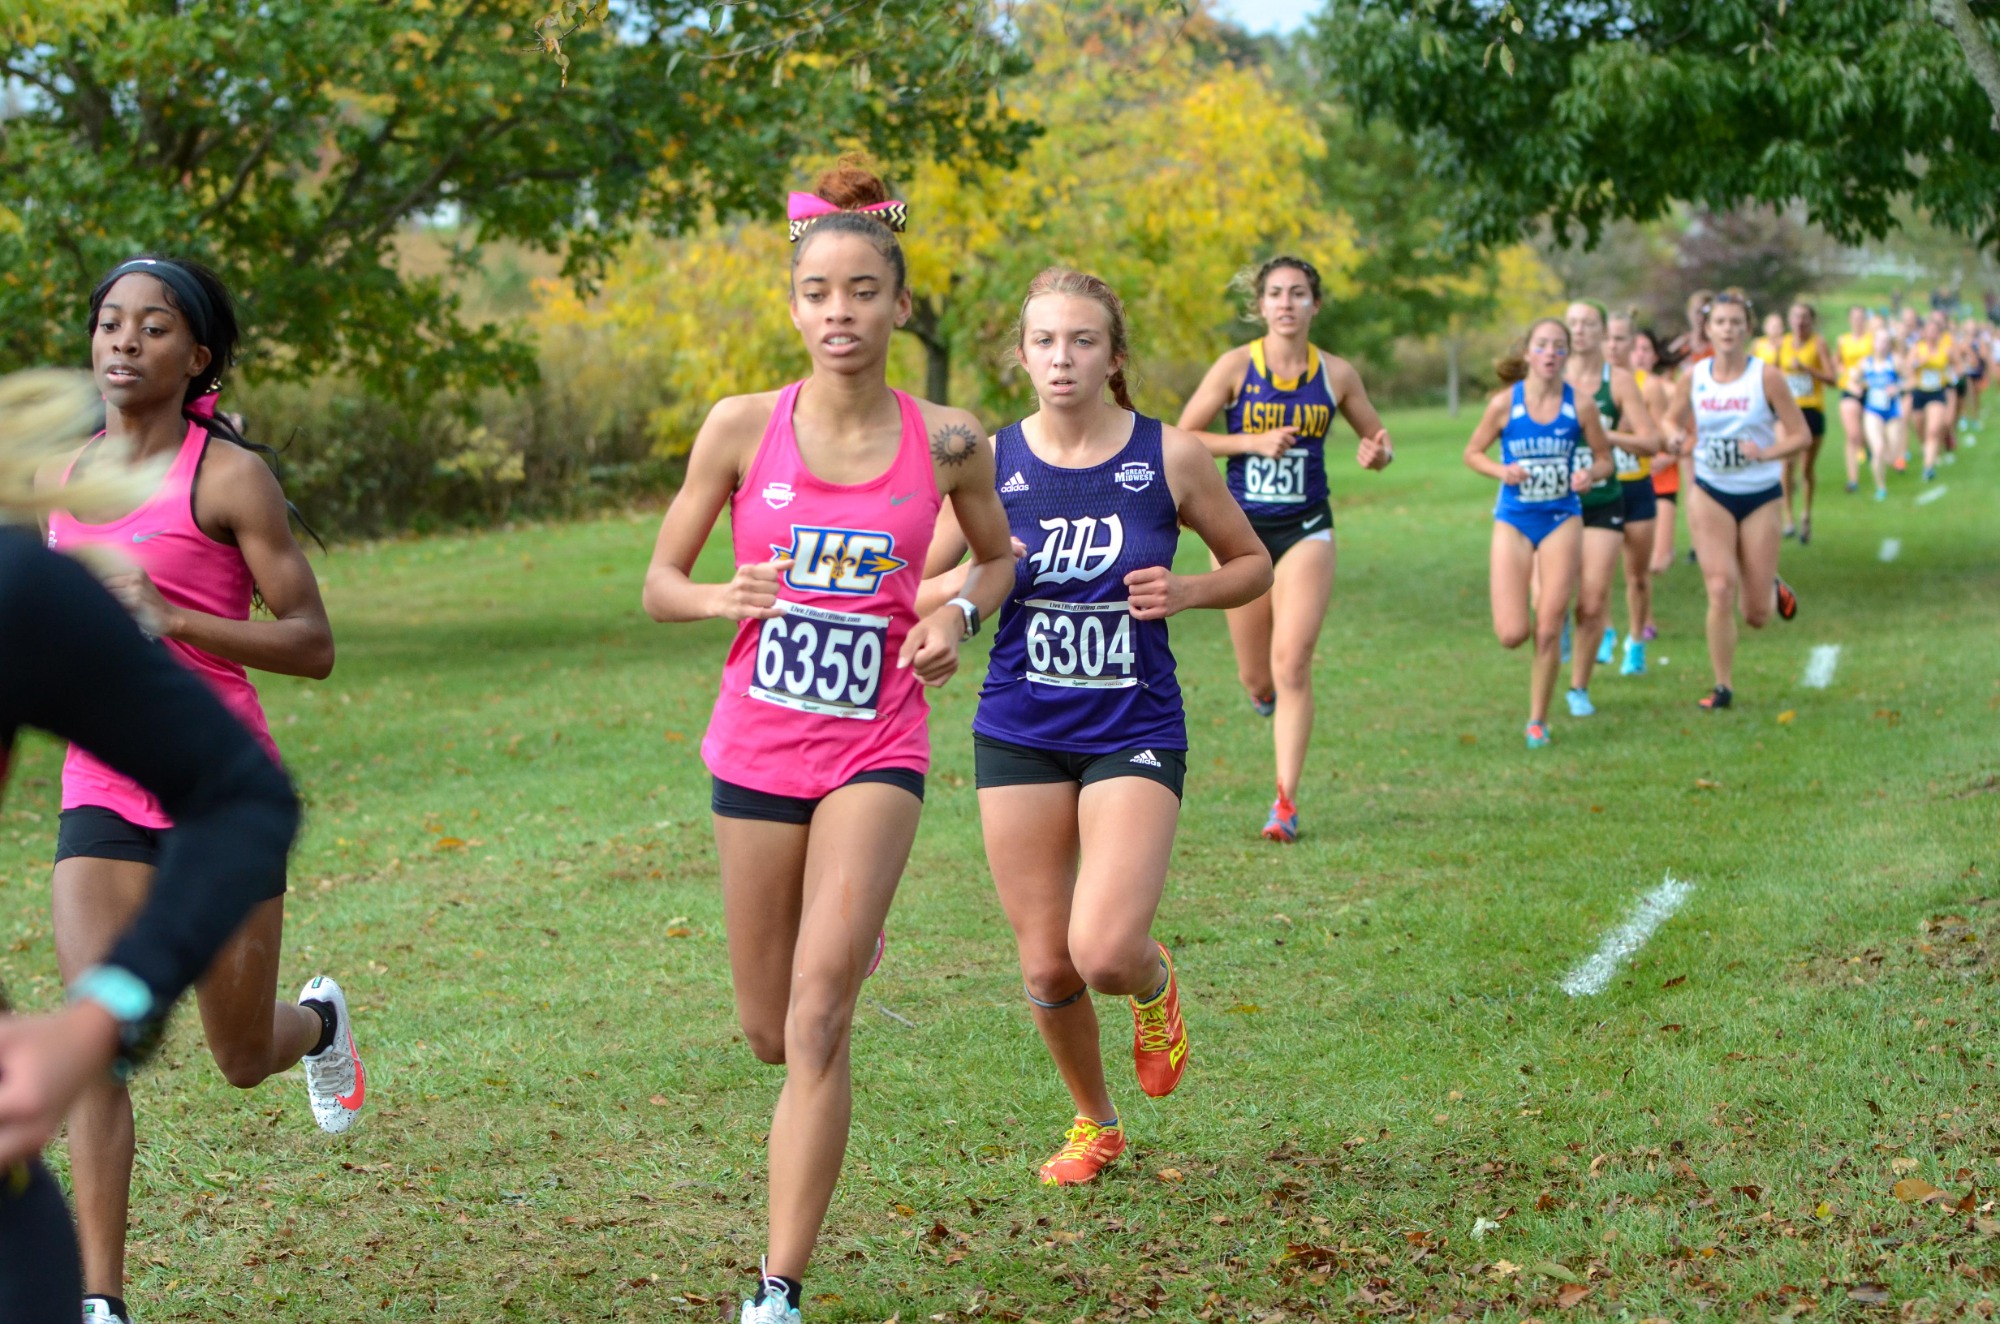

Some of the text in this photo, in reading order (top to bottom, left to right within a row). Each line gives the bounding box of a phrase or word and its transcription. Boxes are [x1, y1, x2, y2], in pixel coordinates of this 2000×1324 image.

[1242, 401, 1330, 438] ASHLAND
[1000, 483, 1030, 493] adidas
[1114, 470, 1155, 483] MIDWEST
[1124, 468, 1147, 476] GREAT
[1246, 456, 1305, 494] 6251
[1519, 464, 1569, 496] 6293
[1026, 611, 1135, 677] 6304
[757, 616, 882, 706] 6359
[1129, 757, 1162, 768] adidas
